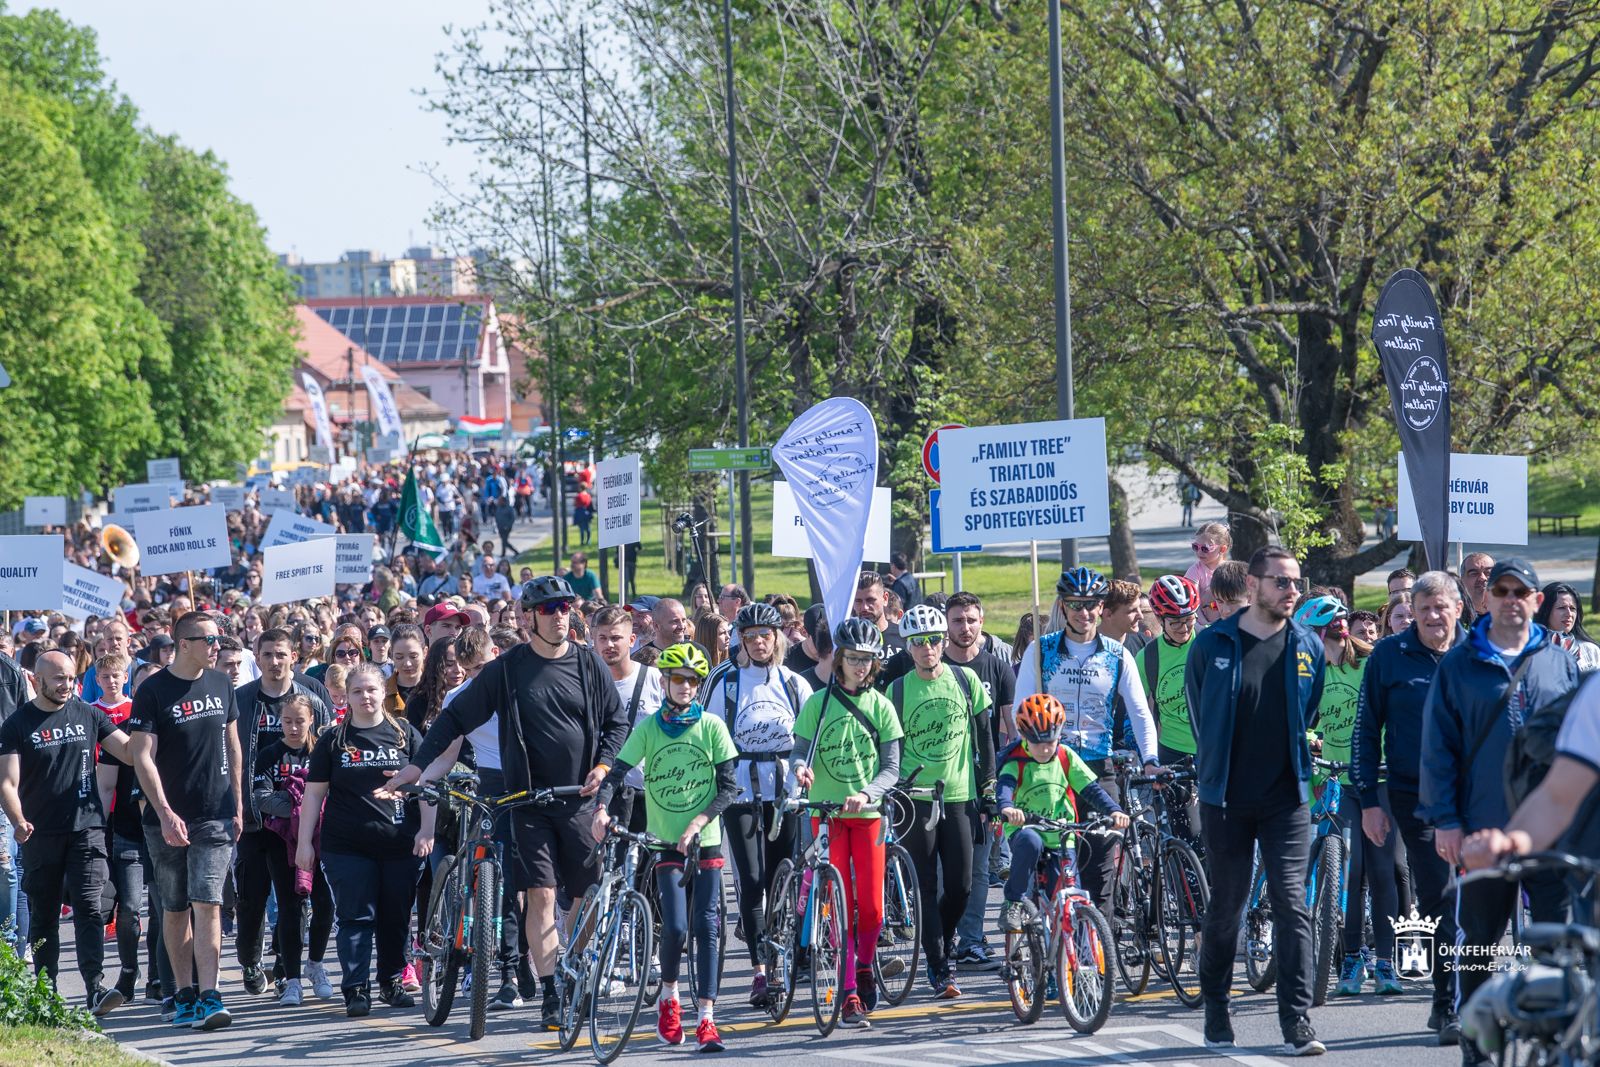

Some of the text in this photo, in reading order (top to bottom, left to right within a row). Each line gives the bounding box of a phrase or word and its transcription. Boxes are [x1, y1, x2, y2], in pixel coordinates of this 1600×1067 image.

[972, 436, 1071, 463] „FAMILY TREE”
[603, 472, 633, 490] FEHÉRVÁRI SAKK
[989, 461, 1056, 483] TRIATLON
[607, 492, 627, 510] EGYESÜLET
[970, 480, 1078, 508] ÉS SZABADIDŐS
[1448, 501, 1494, 515] BY CLUB
[604, 516, 609, 530] TE
[964, 504, 1086, 532] SPORTEGYESÜLET
[147, 538, 216, 555] ROCK AND ROLL SE
[275, 564, 324, 580] FREE SPIRIT TSE
[1060, 668, 1100, 677] JANOTA
[172, 694, 223, 718] SUDÁR
[31, 723, 86, 743] SUDÁR
[667, 746, 682, 755] BIKE
[656, 778, 710, 798] Triatlon
